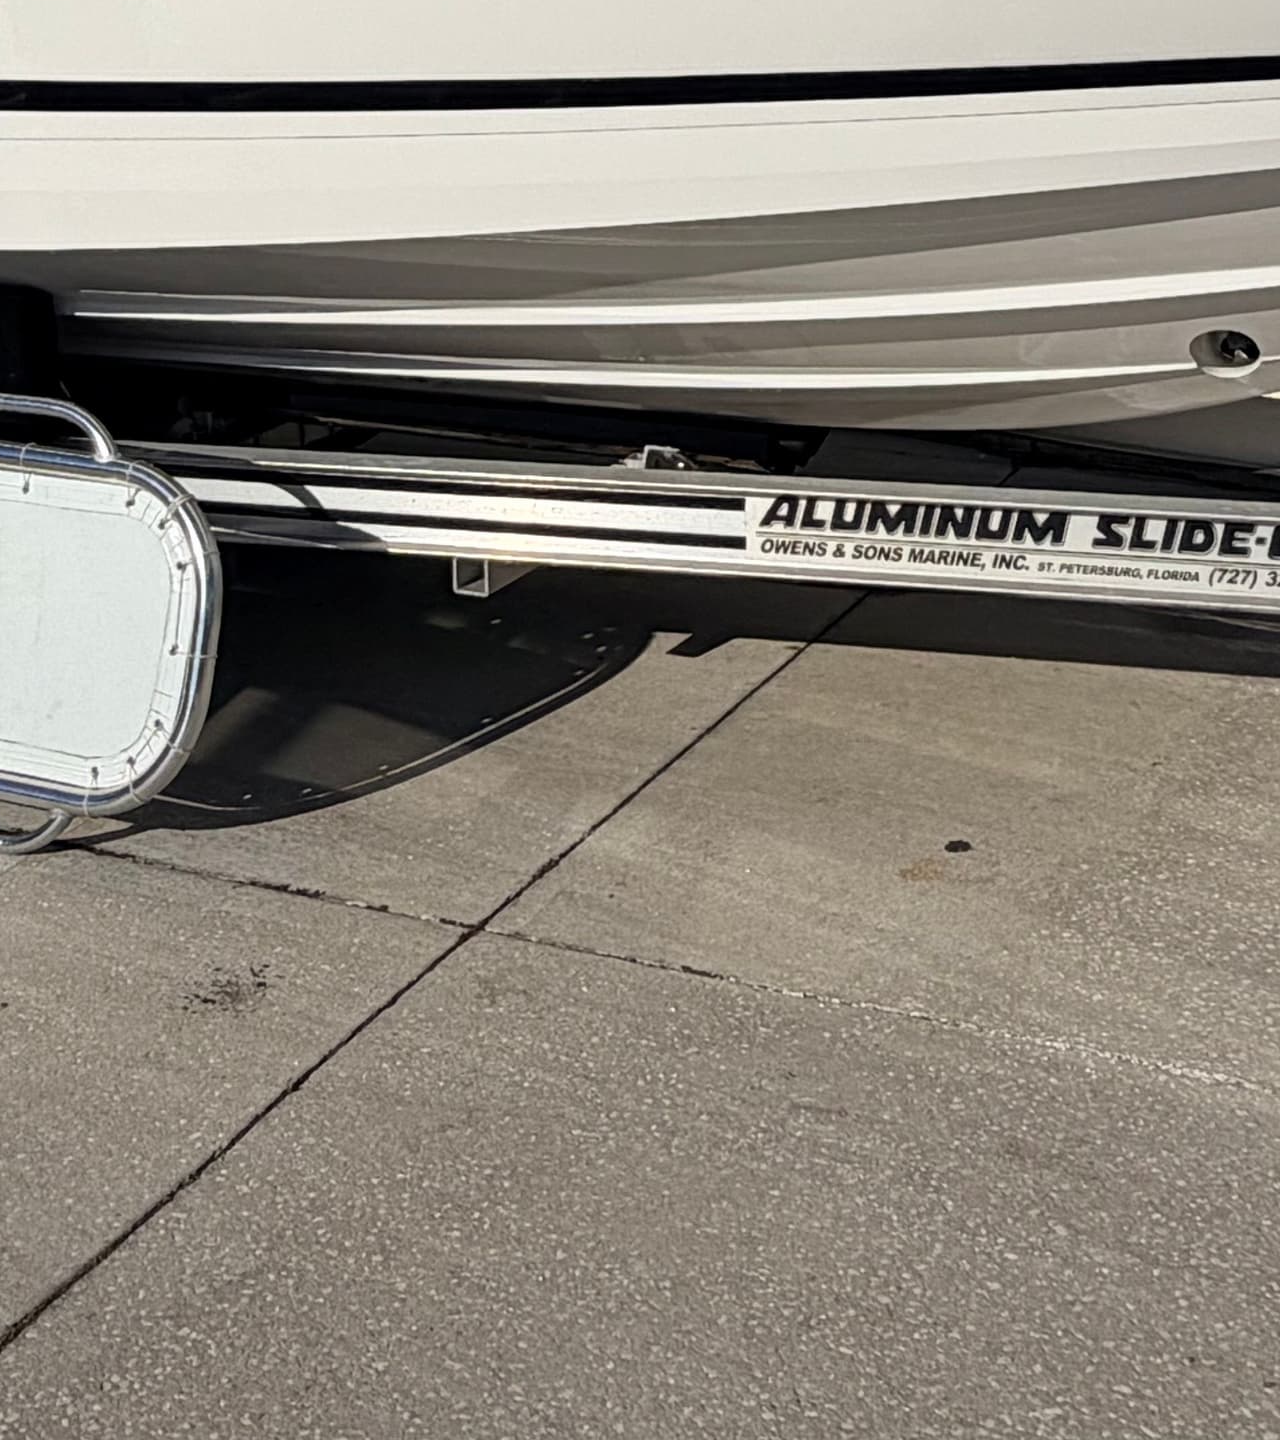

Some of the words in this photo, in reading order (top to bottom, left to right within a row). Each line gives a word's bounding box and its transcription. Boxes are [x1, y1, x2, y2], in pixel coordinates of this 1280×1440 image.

[759, 494, 1070, 546] ALUMINUM
[760, 538, 828, 558] OWENS
[832, 542, 846, 558] &
[851, 544, 903, 562] SONS
[908, 548, 987, 571] MARINE,
[992, 554, 1030, 571] INC.
[1037, 562, 1056, 572] ST.
[1059, 563, 1143, 580] PETERSBURG,
[1146, 570, 1199, 582] FLORIDA
[1208, 568, 1258, 589] (727)
